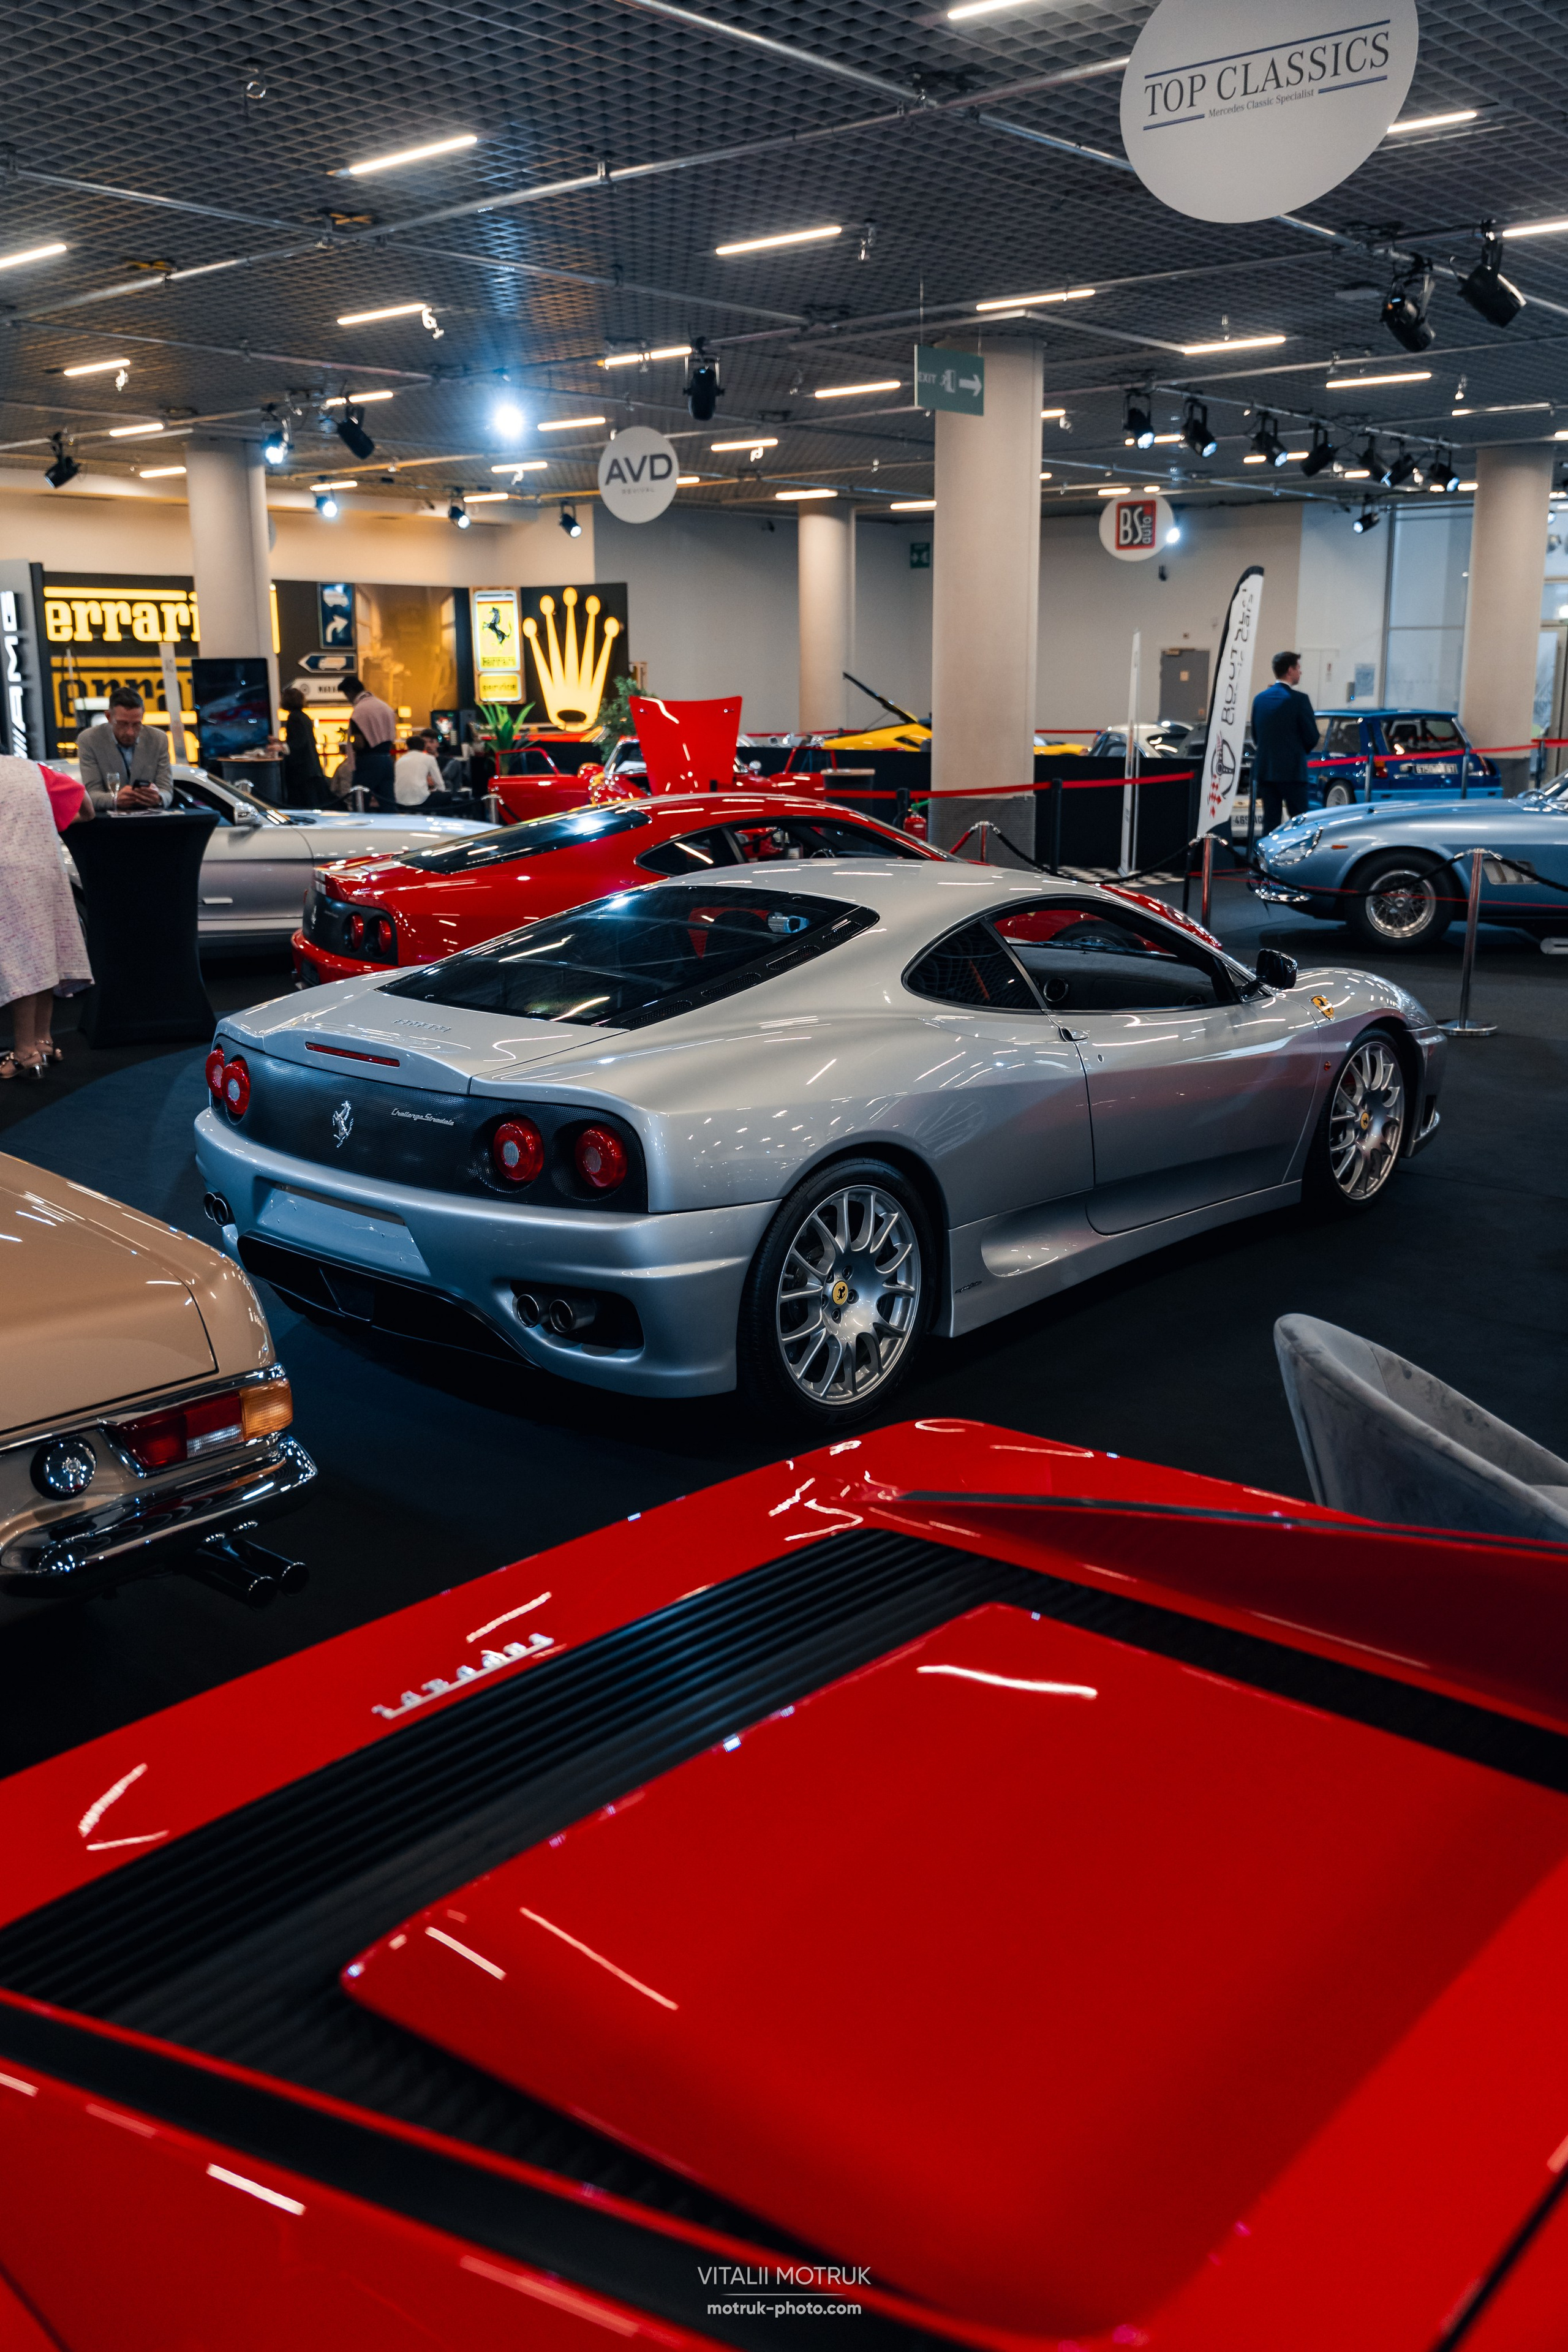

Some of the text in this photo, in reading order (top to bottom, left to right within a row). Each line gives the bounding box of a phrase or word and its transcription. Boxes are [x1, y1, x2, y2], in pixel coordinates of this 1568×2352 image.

[1144, 31, 1390, 117] TOP CLASSICS
[1208, 89, 1314, 118] Mercedes Classic Specialist
[918, 371, 937, 384] EXIT
[604, 452, 673, 486] AVD
[1118, 505, 1144, 546] BS
[1142, 516, 1152, 545] auto
